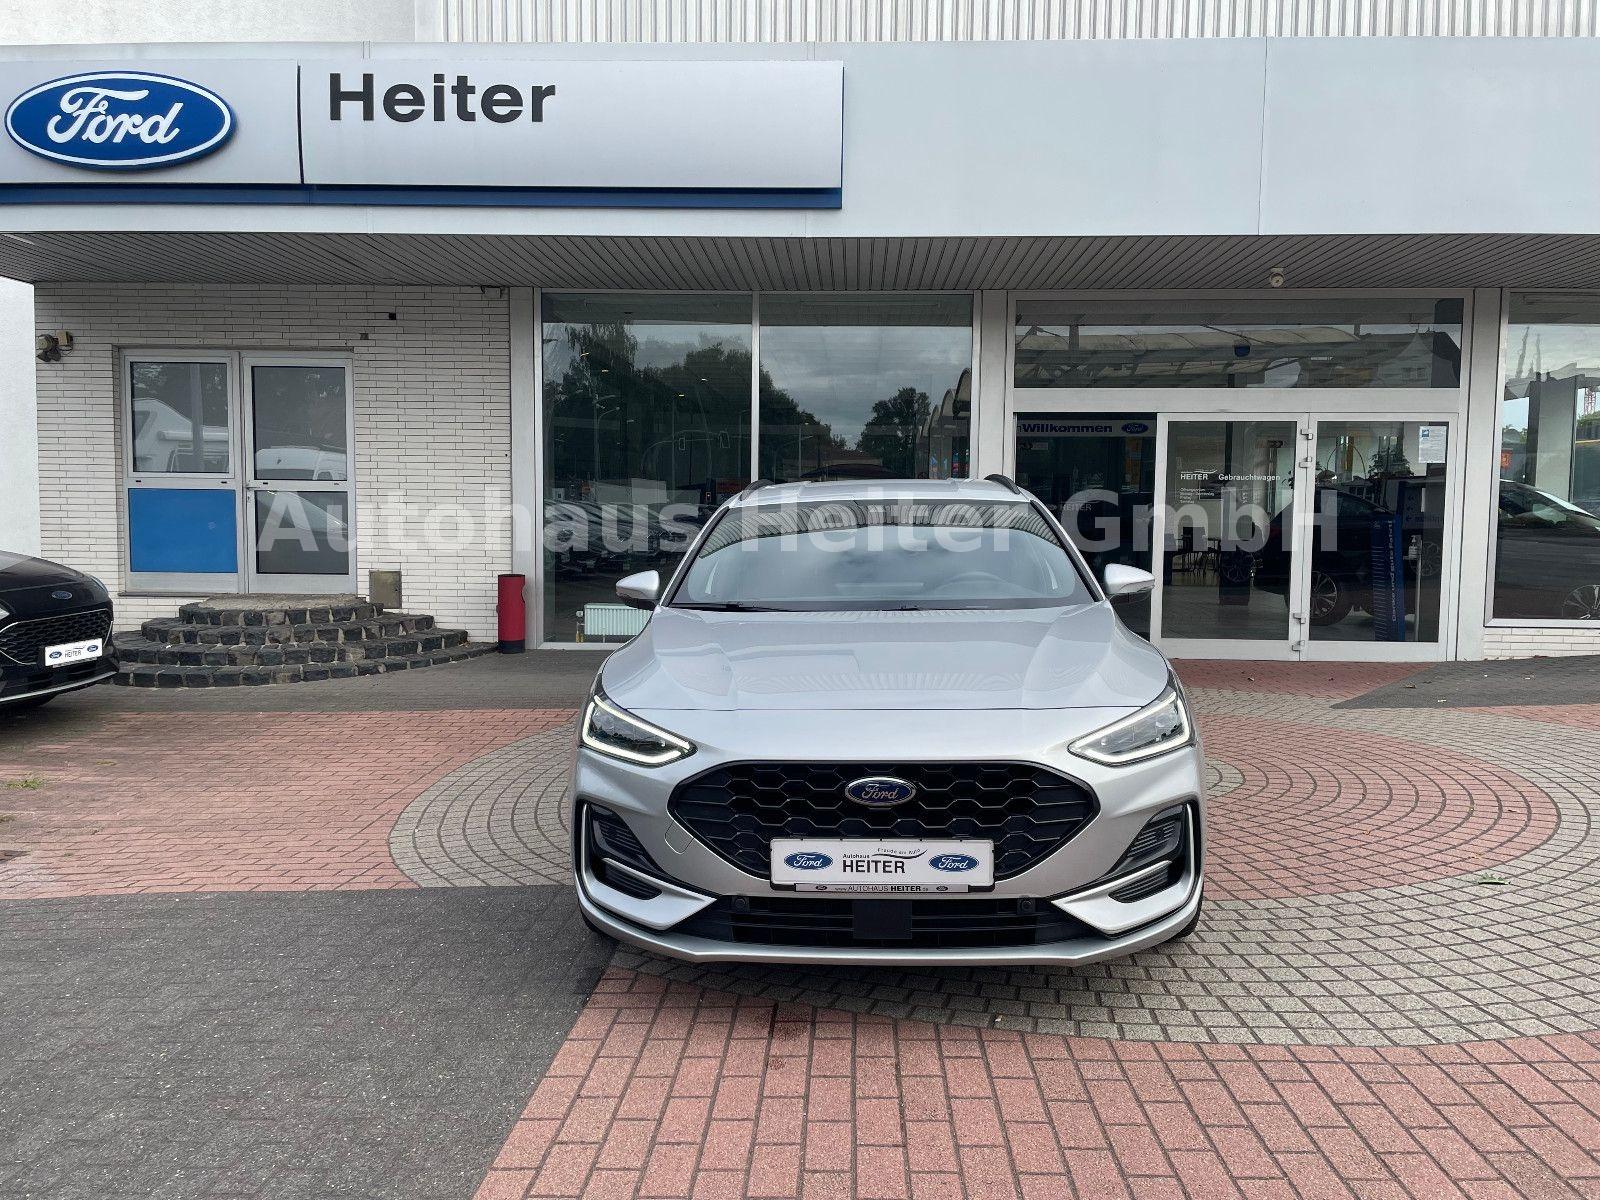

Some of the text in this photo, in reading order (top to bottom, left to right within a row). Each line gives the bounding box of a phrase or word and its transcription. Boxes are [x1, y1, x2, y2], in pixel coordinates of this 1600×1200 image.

[329, 73, 556, 124] Heiter
[47, 86, 184, 144] Ford
[1021, 423, 1113, 433] Willkommen
[861, 783, 899, 800] Ford
[793, 854, 823, 868] Ford
[842, 859, 906, 874] HEITER
[938, 856, 968, 869] Ford
